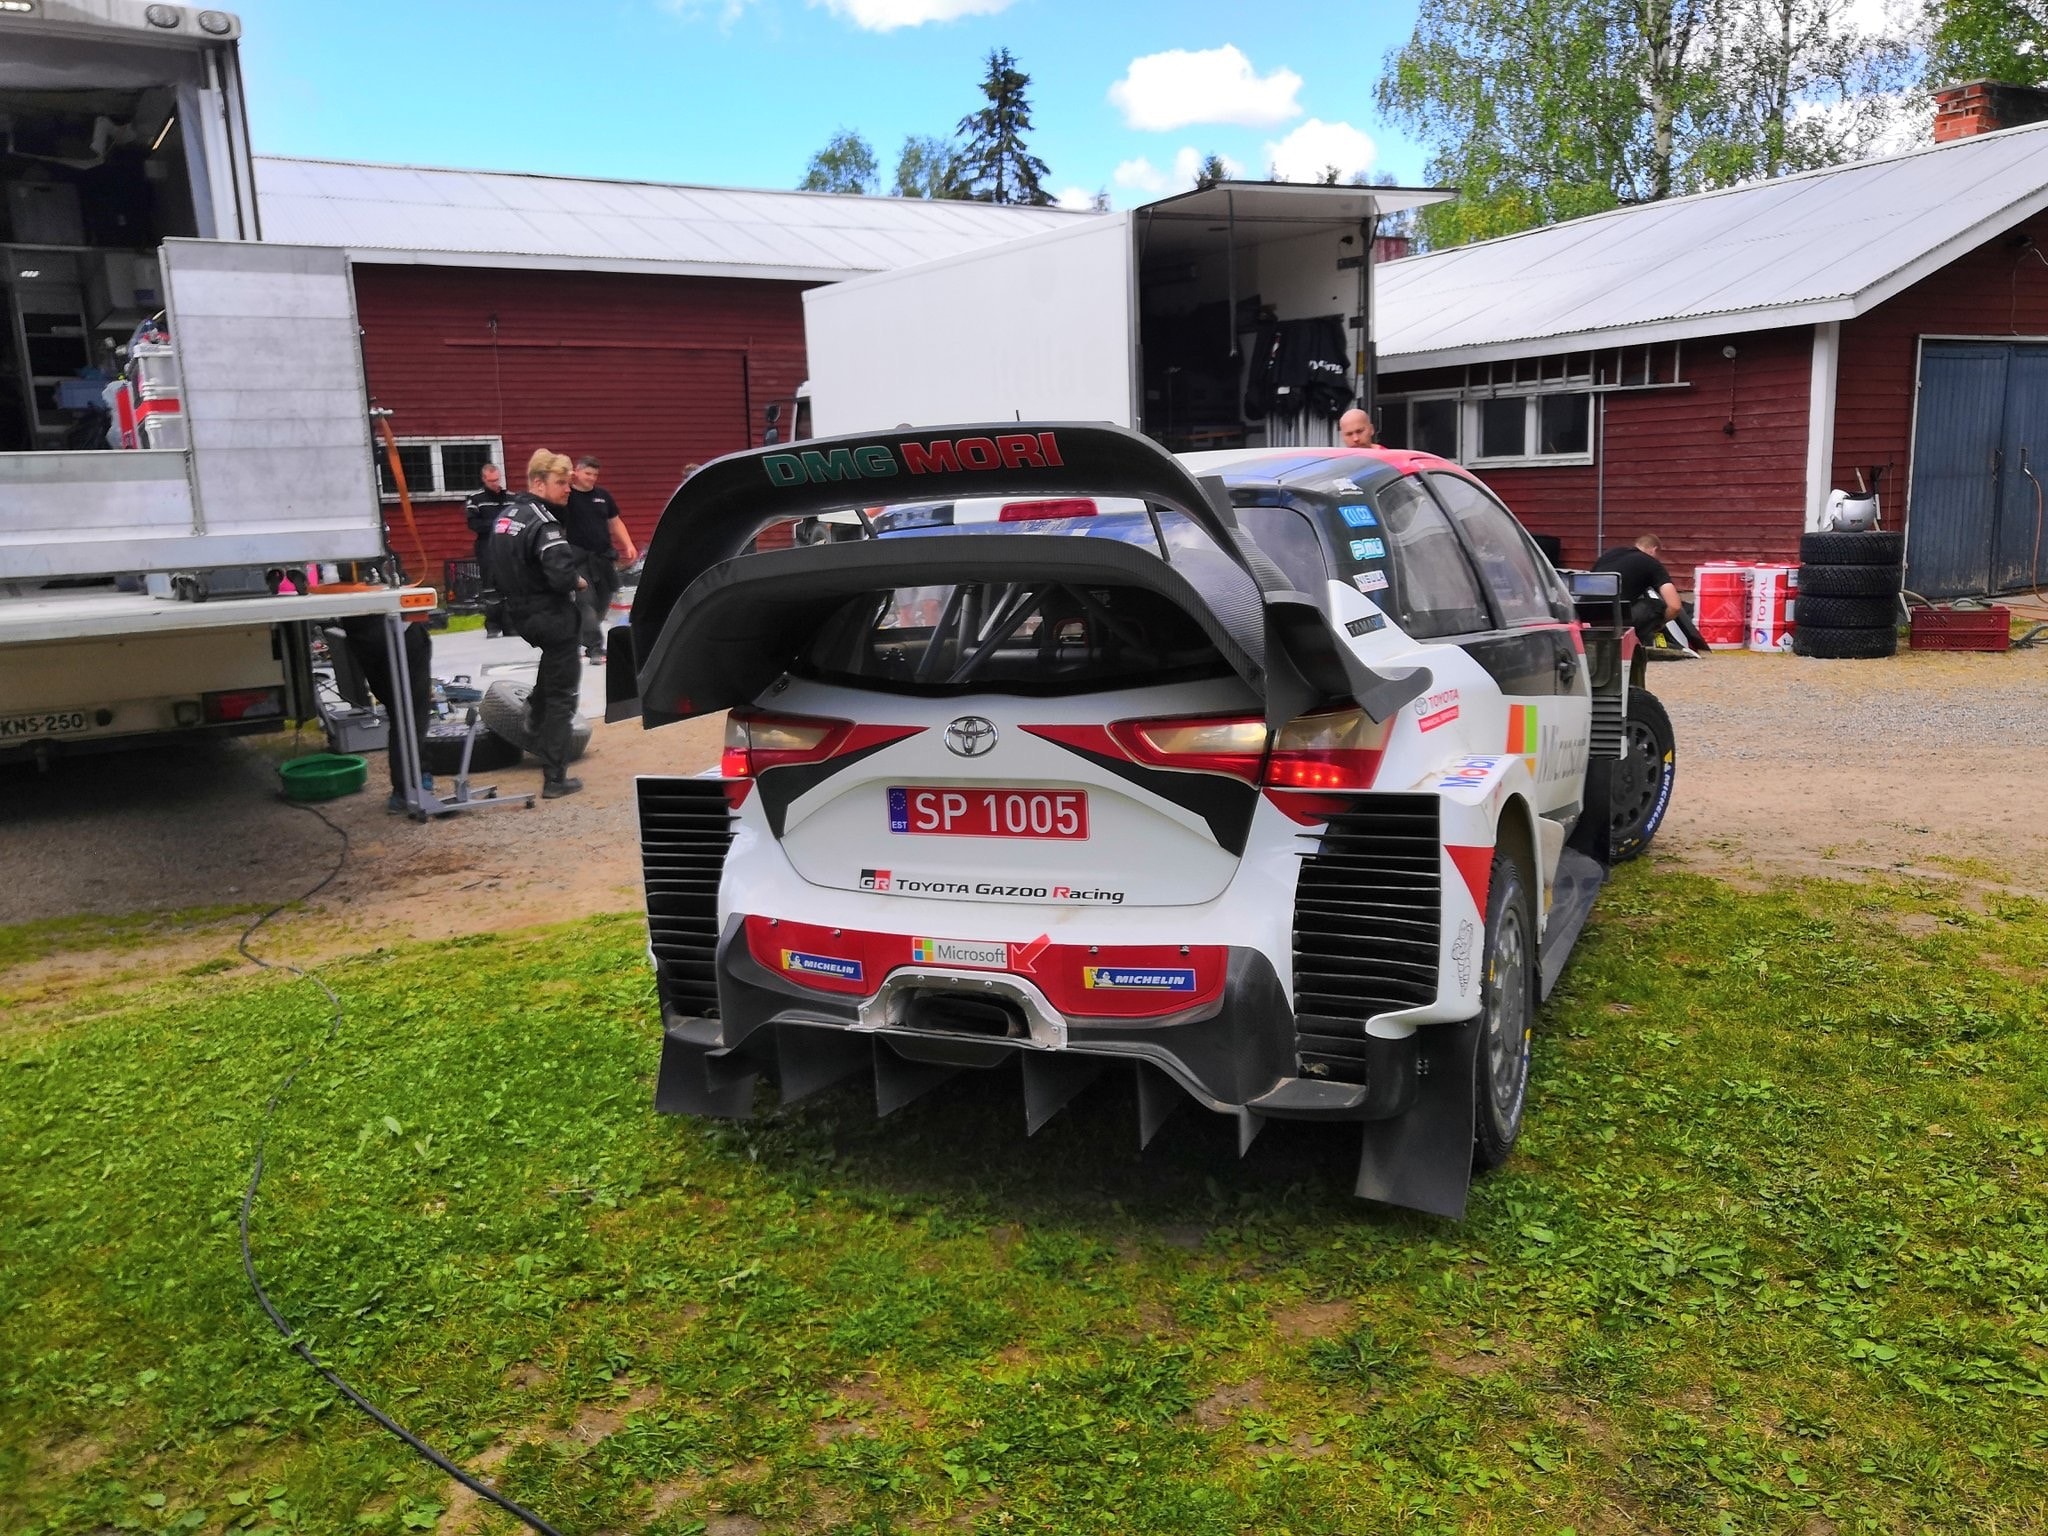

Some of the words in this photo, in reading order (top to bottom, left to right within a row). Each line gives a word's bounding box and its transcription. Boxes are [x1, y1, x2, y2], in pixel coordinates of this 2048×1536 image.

[762, 446, 899, 487] DMG
[899, 432, 1064, 475] MORI
[1757, 577, 1768, 622] TOTAL
[1428, 688, 1459, 709] TOYOTA
[1438, 755, 1502, 788] Mobil
[915, 792, 968, 831] SP
[983, 794, 1079, 835] 1005
[1646, 774, 1671, 832] MICHELIN
[891, 820, 908, 830] EST
[860, 875, 890, 891] GR
[896, 879, 969, 894] TOYOTA
[975, 883, 1047, 898] GAZOO
[1052, 886, 1124, 904] Racing
[803, 959, 855, 974] MICHELIN
[938, 944, 1007, 964] Microsoft
[1115, 975, 1185, 985] MICHELIN
